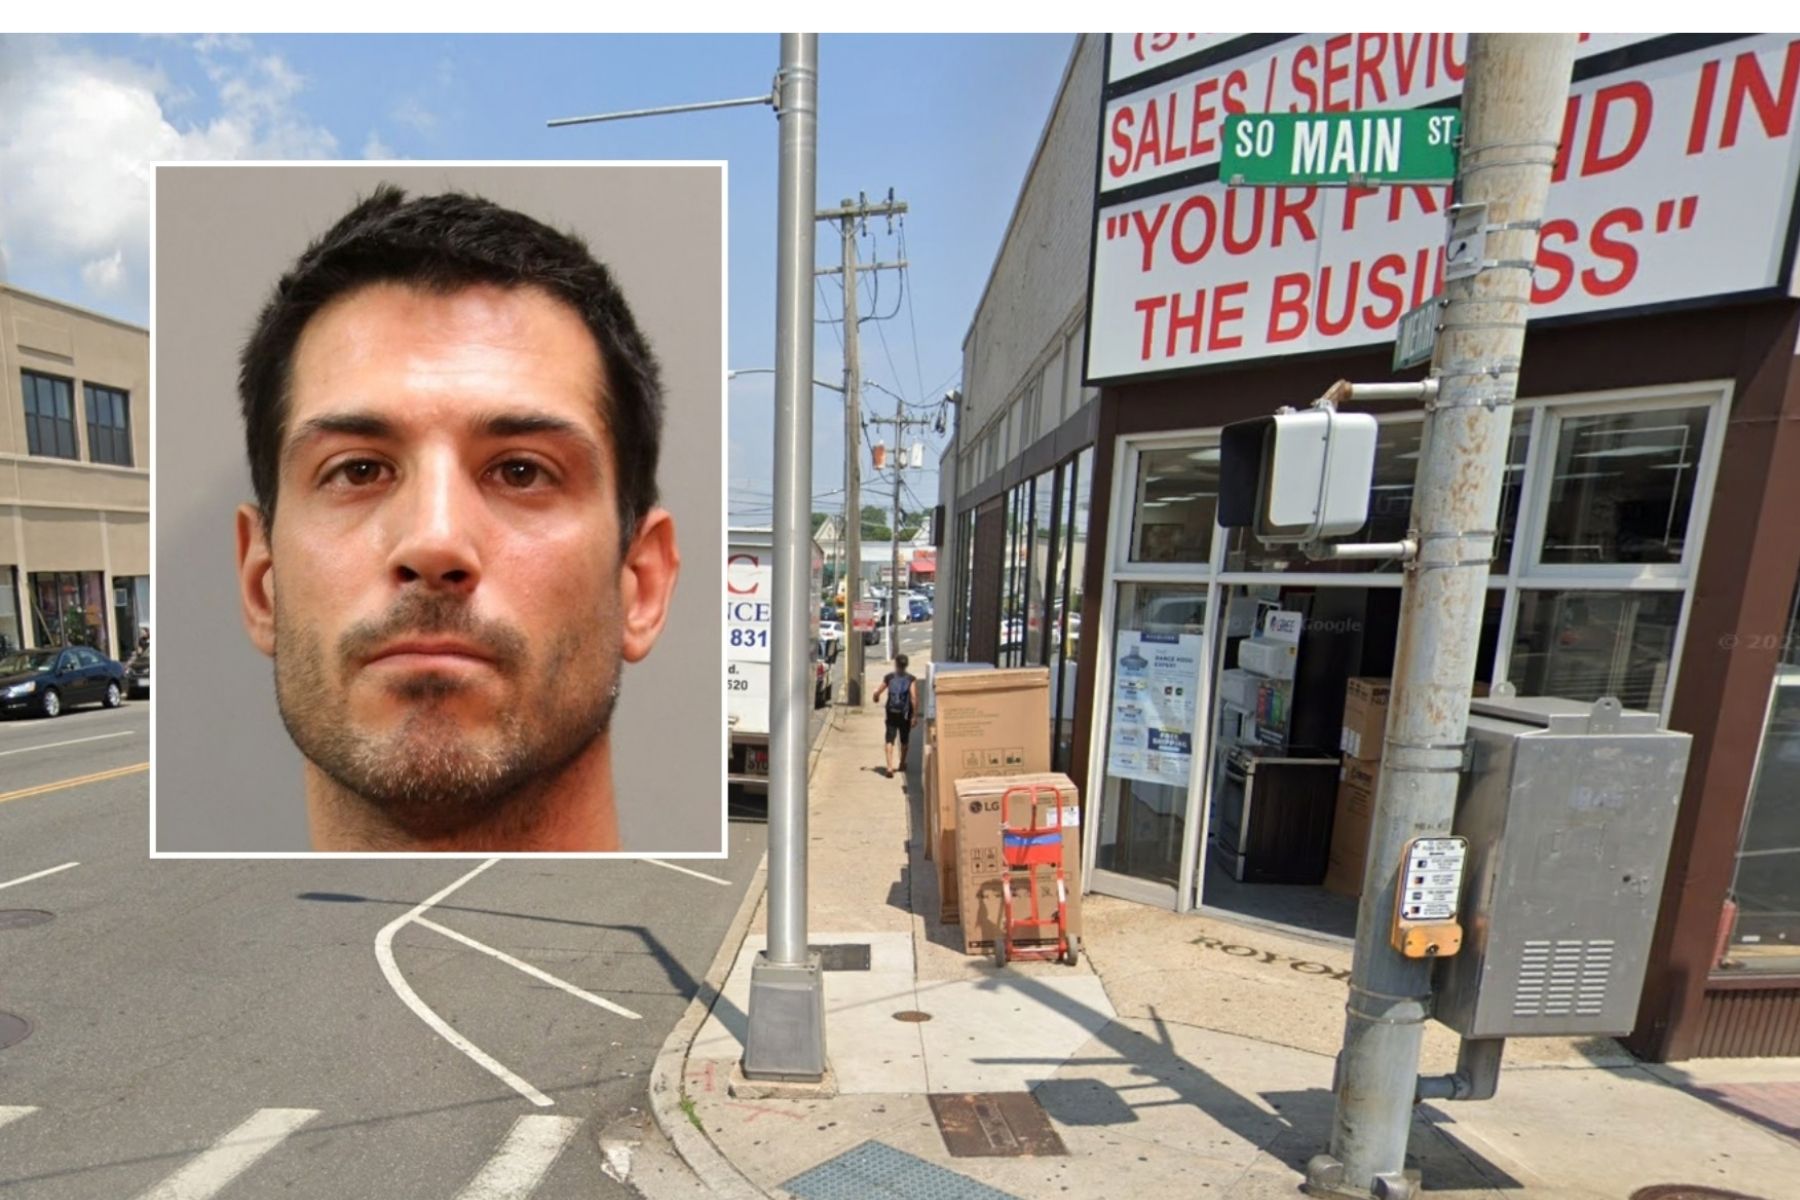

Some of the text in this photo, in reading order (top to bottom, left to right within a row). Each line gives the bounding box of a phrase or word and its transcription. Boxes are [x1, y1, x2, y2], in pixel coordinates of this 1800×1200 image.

[1106, 186, 1318, 273] "YOUR
[1687, 39, 1800, 156] IN
[1108, 69, 1248, 177] SALES
[1235, 115, 1456, 176] SO MAIN ST
[1135, 281, 1249, 361] THE
[1266, 195, 1699, 344] BUSISS"
[730, 628, 767, 648] 831
[984, 801, 1000, 812] LG
